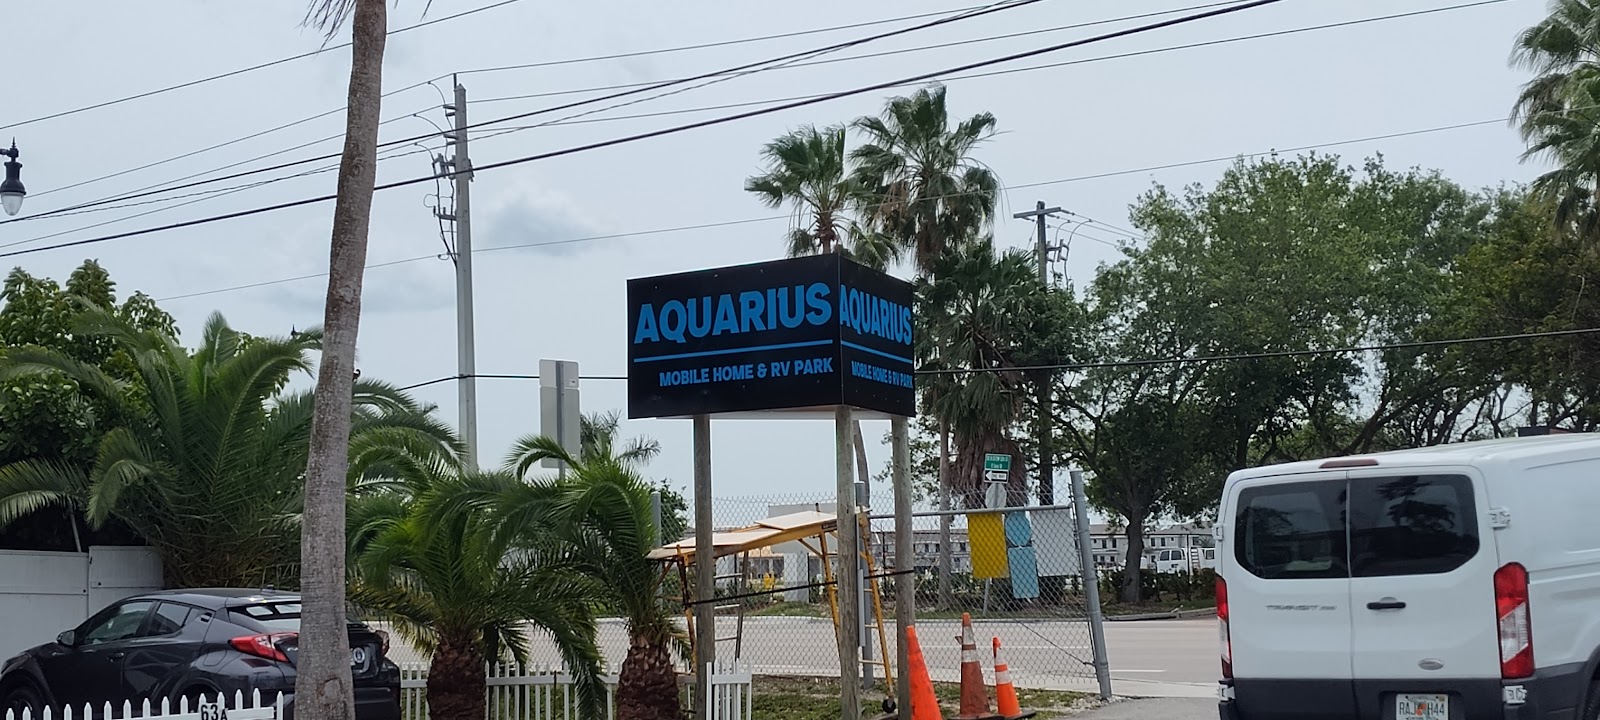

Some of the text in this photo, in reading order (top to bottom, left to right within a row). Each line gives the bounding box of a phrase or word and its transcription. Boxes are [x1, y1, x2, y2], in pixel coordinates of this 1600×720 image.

[633, 282, 833, 344] AQUARIUS
[840, 284, 913, 345] AQUARIUS
[659, 357, 834, 387] MOBILE HOME & RV PARK
[851, 361, 914, 389] MOBILE HOME & RV PARK
